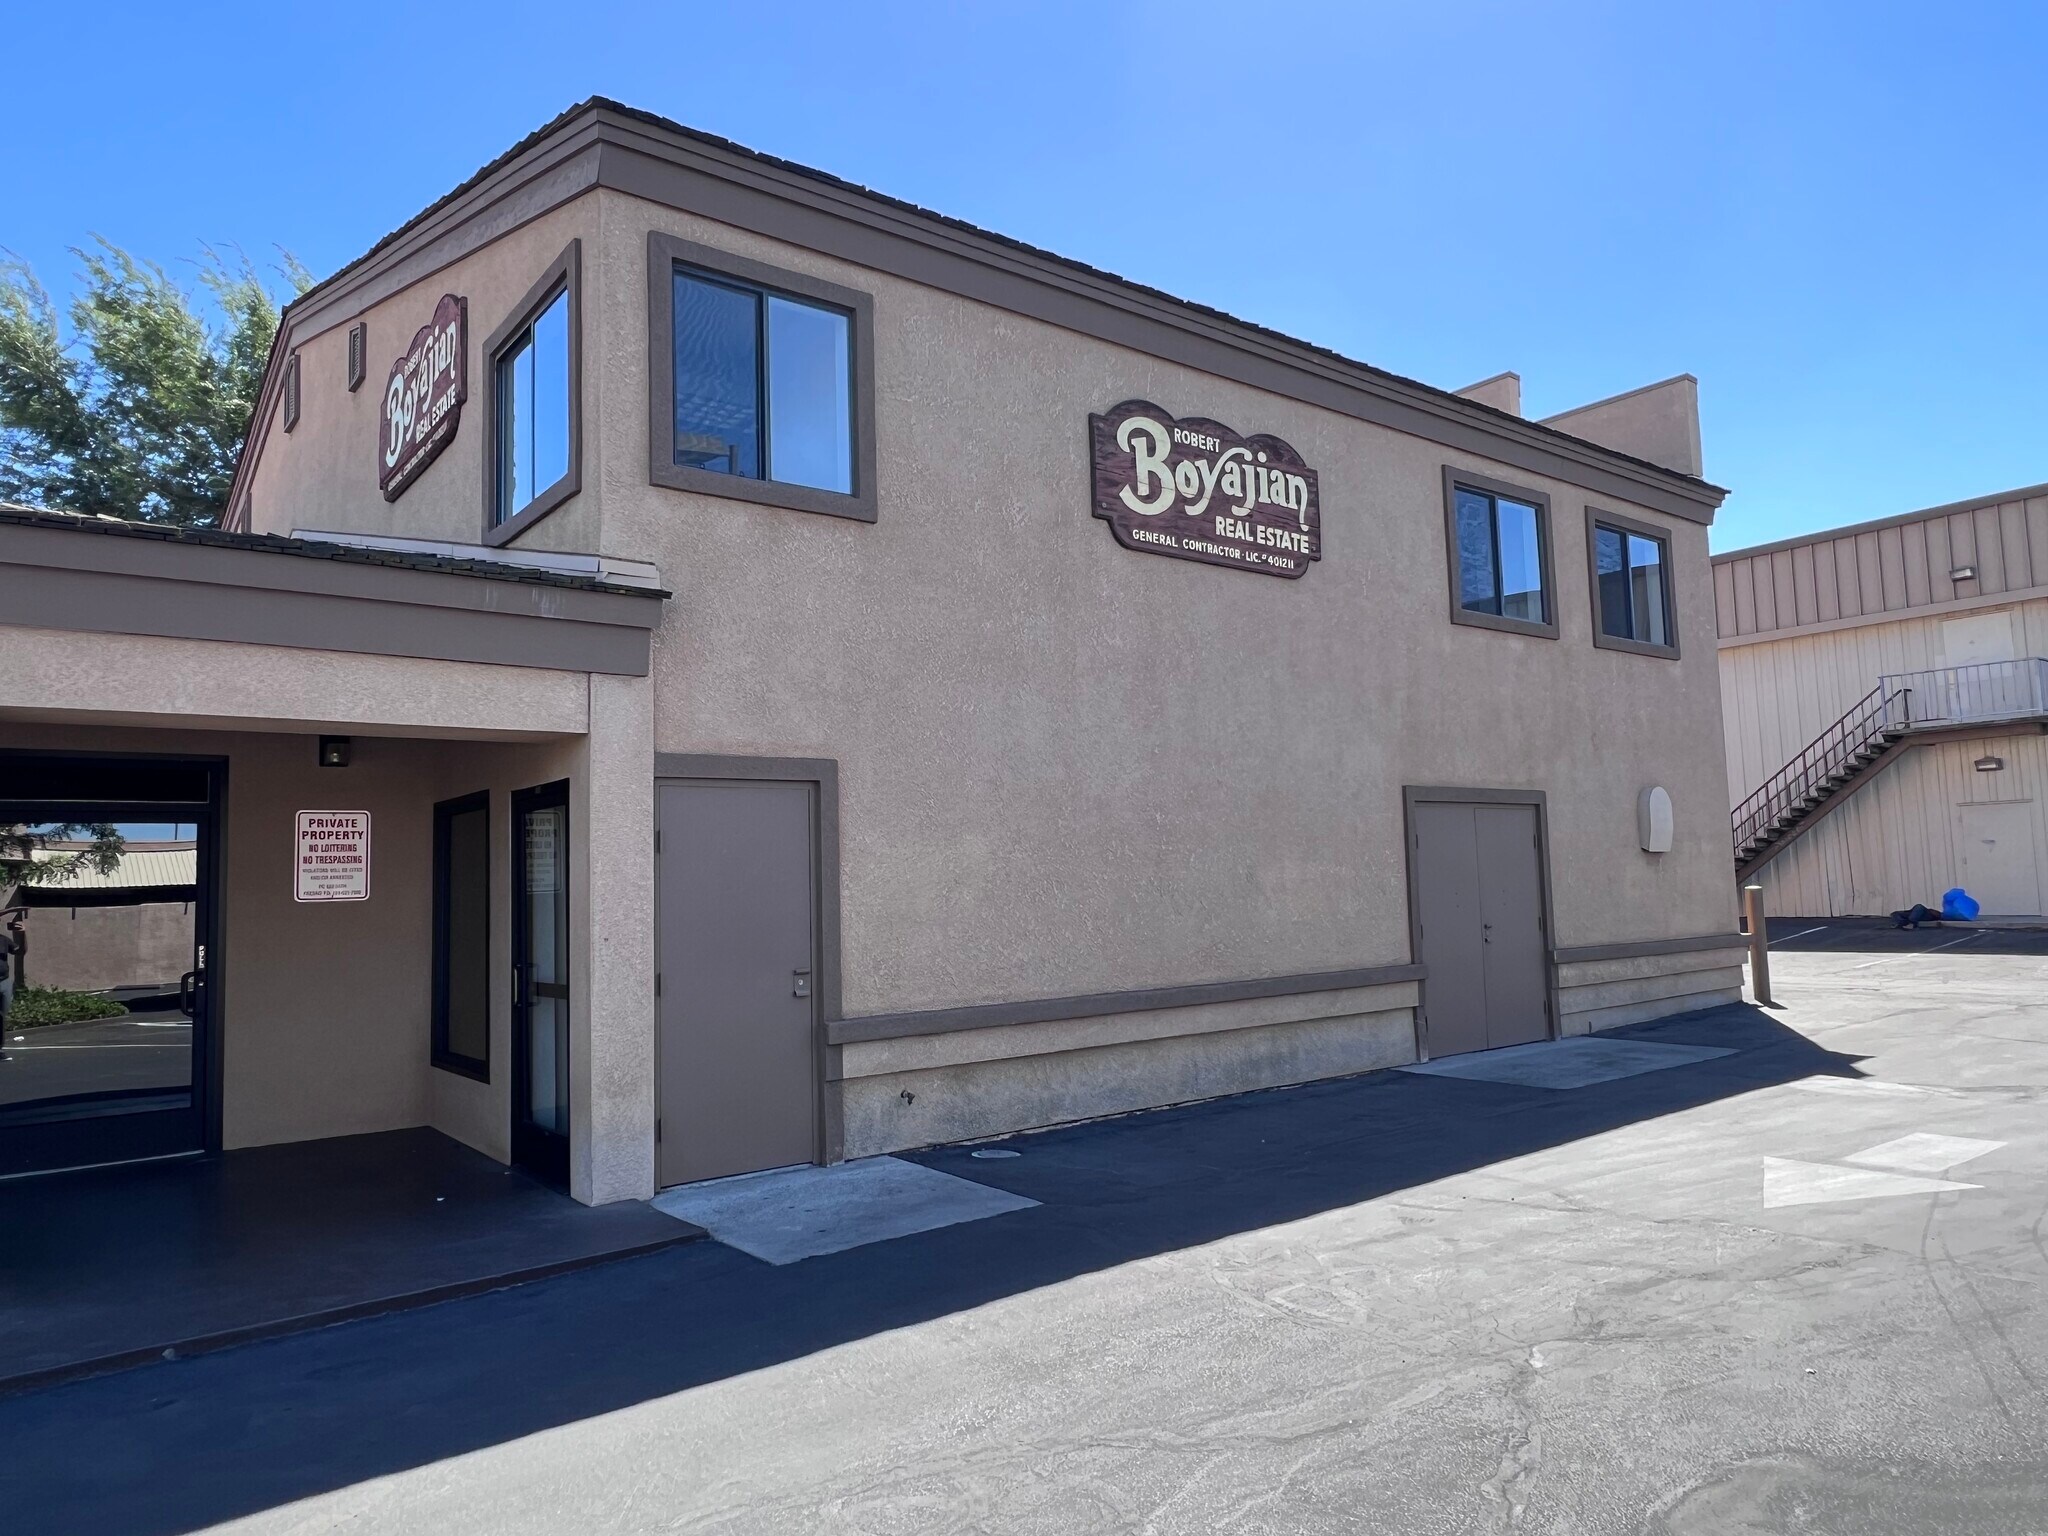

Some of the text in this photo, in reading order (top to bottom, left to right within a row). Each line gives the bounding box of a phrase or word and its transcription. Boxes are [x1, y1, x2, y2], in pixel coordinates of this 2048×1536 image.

[385, 321, 456, 468] Boyajian
[415, 412, 431, 444] REAL
[431, 383, 456, 427] ESTATE
[1174, 428, 1221, 453] ROBERT
[1116, 416, 1309, 532] Boyajian
[1132, 529, 1178, 548] GENERAL
[1182, 539, 1241, 560] CONTRACTOR
[1215, 516, 1309, 554] REAL ESTATE
[301, 830, 364, 840] PROPERTY
[309, 819, 357, 828] PRIVATE
[302, 855, 363, 864] NO TRESPASSING
[308, 843, 357, 853] NO LOITERING
